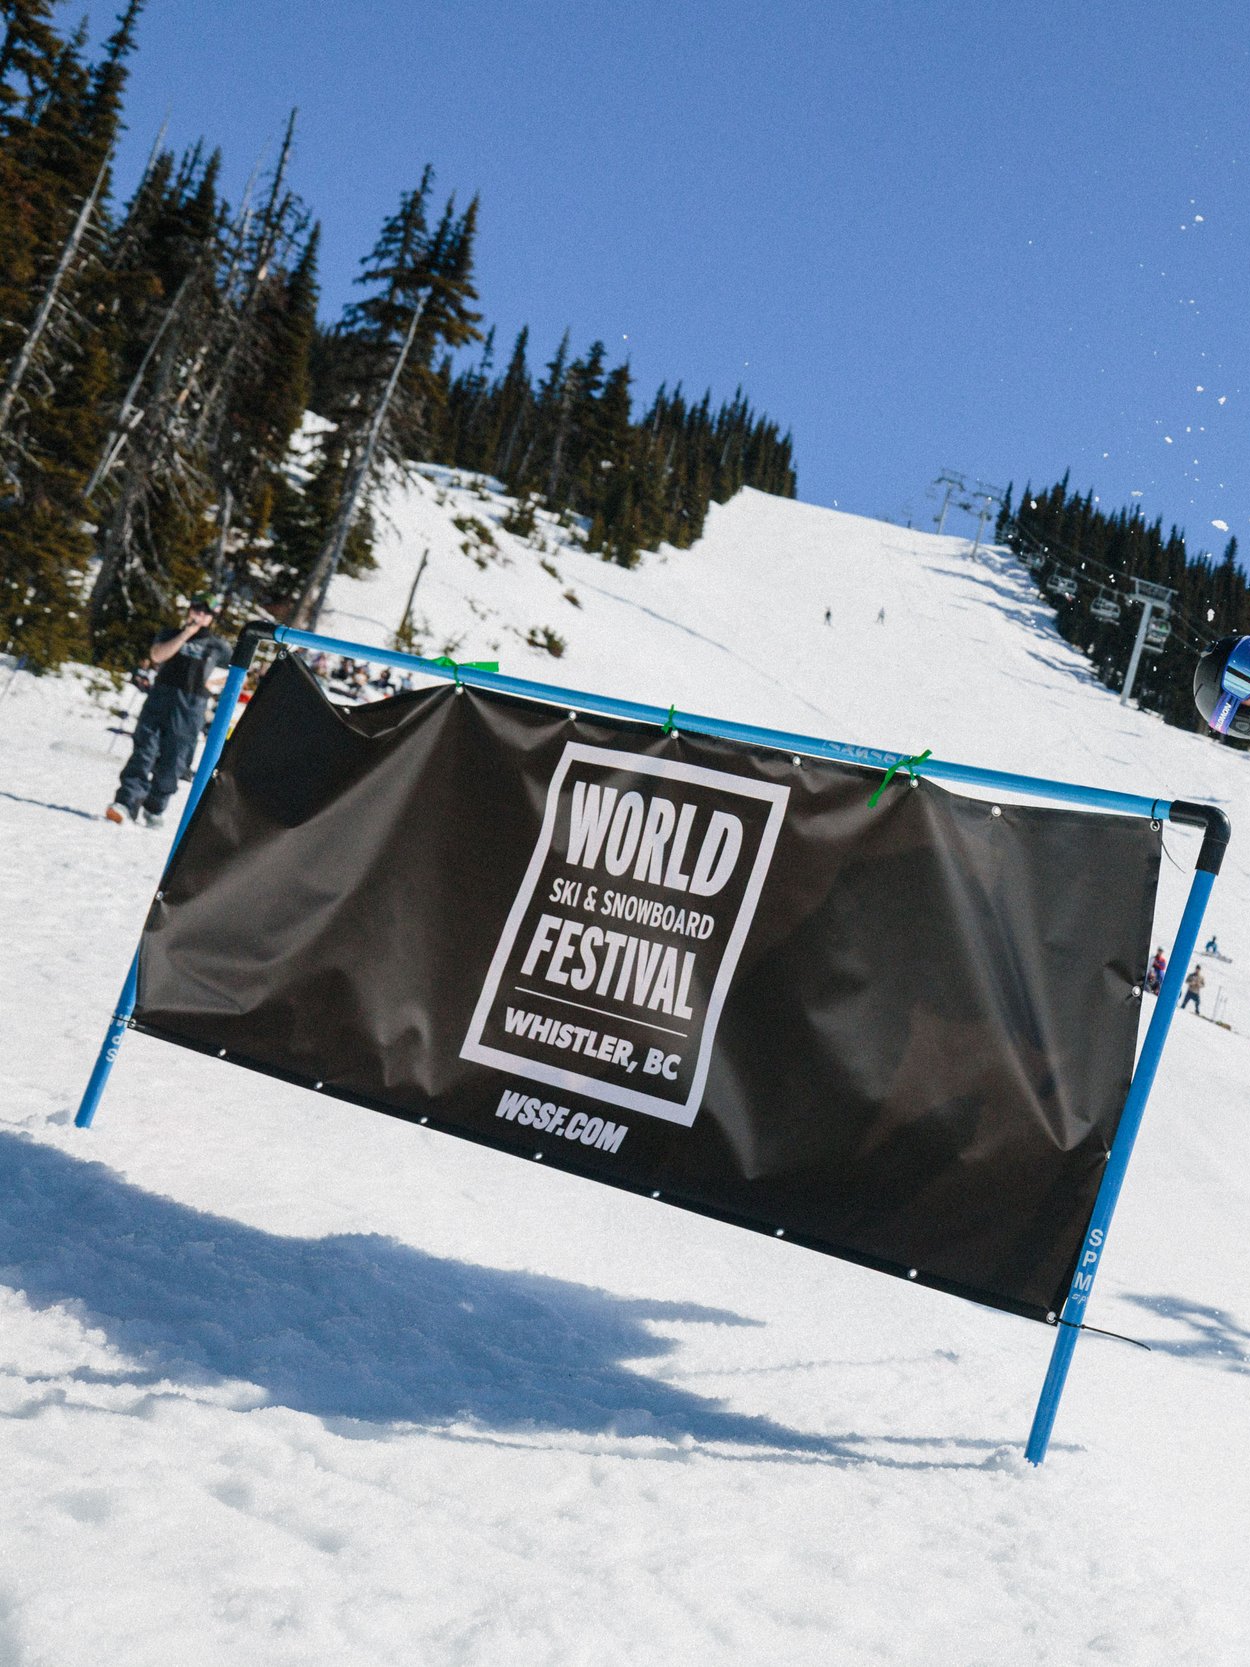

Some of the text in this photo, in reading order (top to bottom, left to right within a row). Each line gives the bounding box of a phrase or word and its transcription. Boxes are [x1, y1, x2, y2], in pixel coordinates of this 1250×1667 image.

[566, 781, 743, 897] WORLD
[549, 878, 715, 940] SKI & SNOWBOARD
[520, 913, 696, 1020] FESTIVAL
[505, 1006, 682, 1081] WHISTLER, BC
[495, 1089, 629, 1154] WSSF.COM
